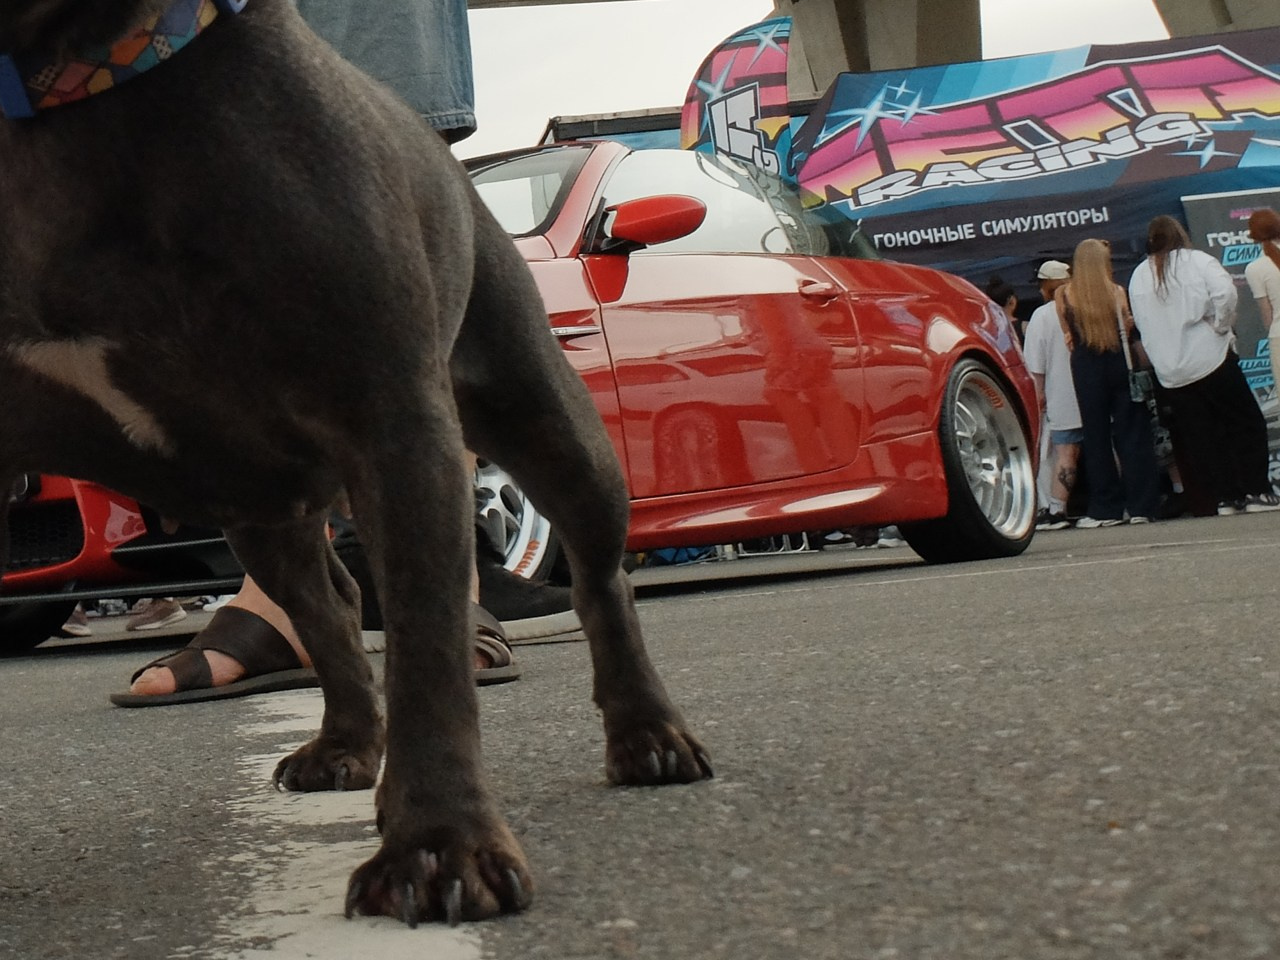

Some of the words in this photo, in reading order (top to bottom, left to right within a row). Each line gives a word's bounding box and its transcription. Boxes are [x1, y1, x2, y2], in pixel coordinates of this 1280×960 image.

[857, 112, 1202, 207] RACING
[873, 223, 976, 249] ГОНОЧНЫЕ
[981, 206, 1109, 238] СИМУЛЯТОРЫ
